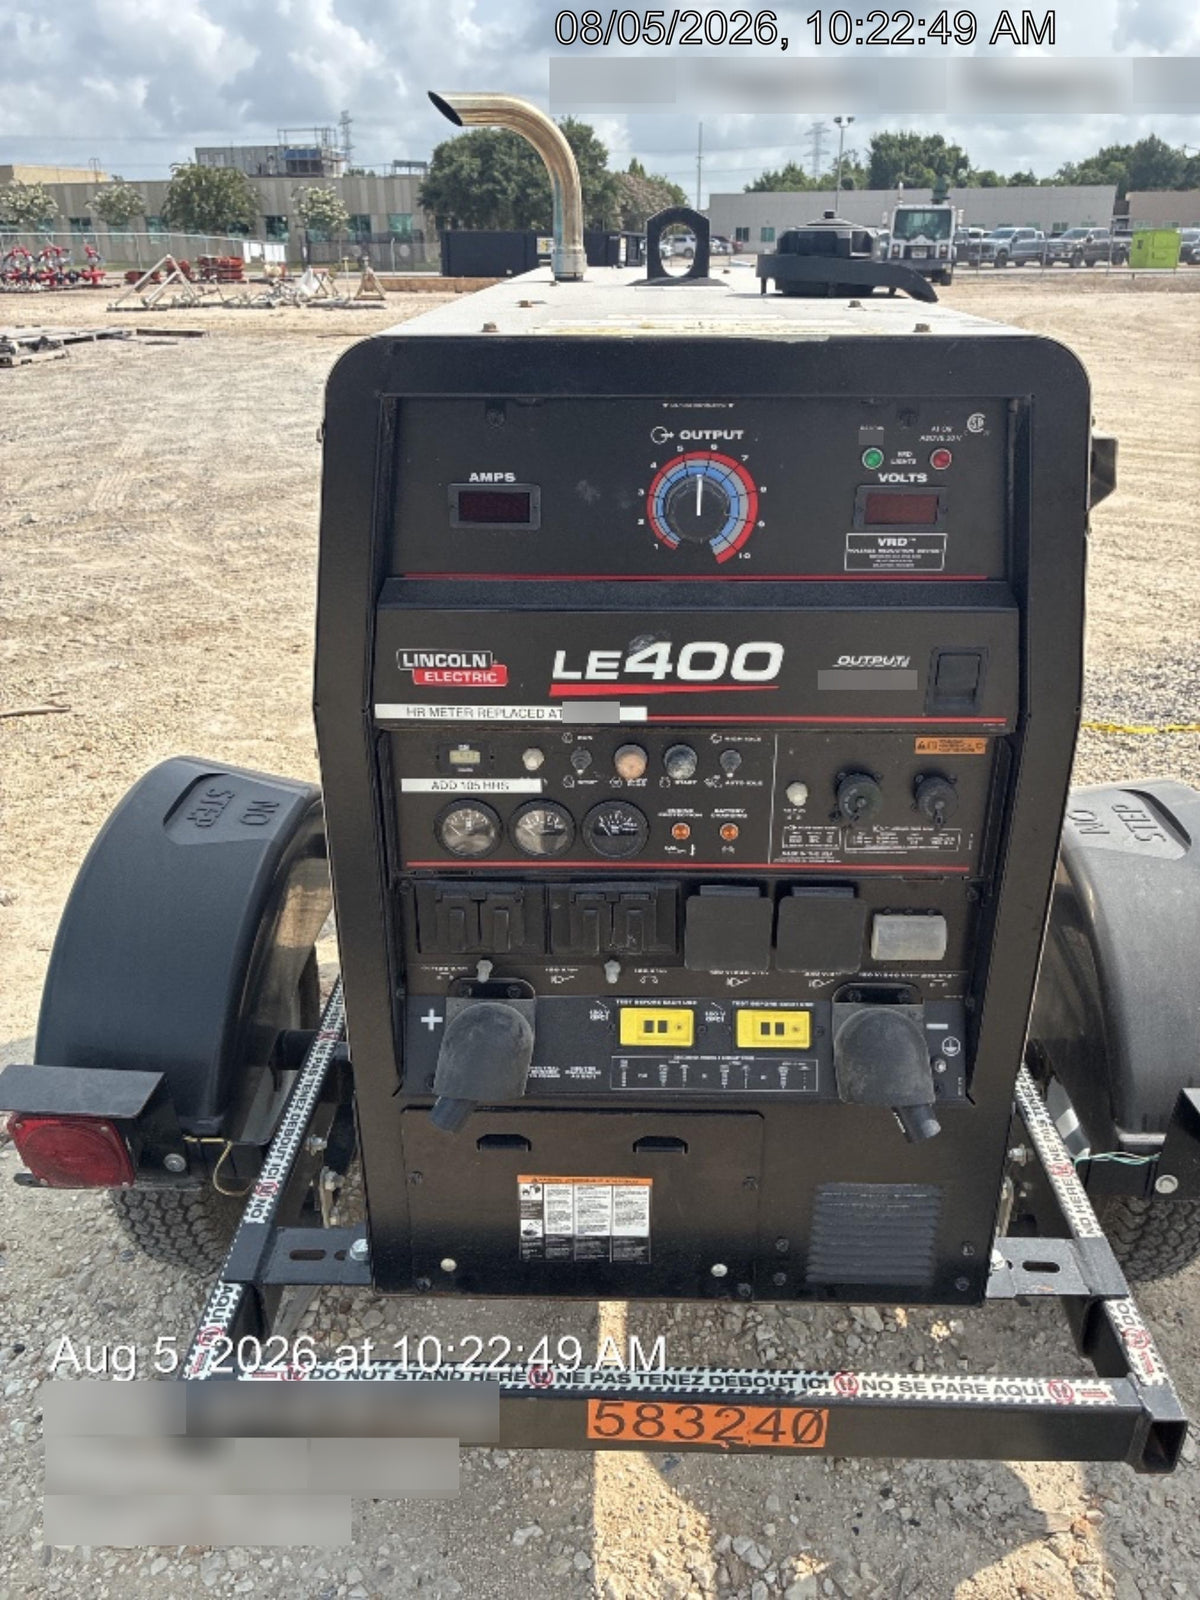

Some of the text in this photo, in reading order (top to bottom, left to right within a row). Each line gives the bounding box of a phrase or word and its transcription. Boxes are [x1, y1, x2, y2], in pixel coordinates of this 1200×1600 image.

[679, 430, 744, 440] OUTPUT
[469, 472, 516, 482] AMPS
[878, 473, 928, 483] VOLTS
[403, 653, 487, 668] LINCOLN
[552, 641, 785, 681] LE400
[424, 671, 498, 684] ELECTRIC
[406, 707, 562, 719] HR METER REPLACED AT
[431, 780, 457, 790] ADD
[187, 788, 235, 828] STEP
[240, 801, 280, 826] NO
[1067, 809, 1110, 834] NO
[1111, 804, 1167, 842] STEP
[275, 1114, 301, 1159] DEBOUT
[266, 1164, 282, 1179] ICI
[1063, 1178, 1087, 1214] HERE
[309, 1368, 339, 1380] DO
[394, 1369, 464, 1381] STAND
[469, 1371, 527, 1382] HERE
[557, 1372, 829, 1389] NE PAS TENEZ DEBOUT ICI
[862, 1380, 893, 1392] NO
[900, 1380, 927, 1392] SE
[931, 1382, 988, 1395] PARE
[592, 1402, 824, 1445] 583240
